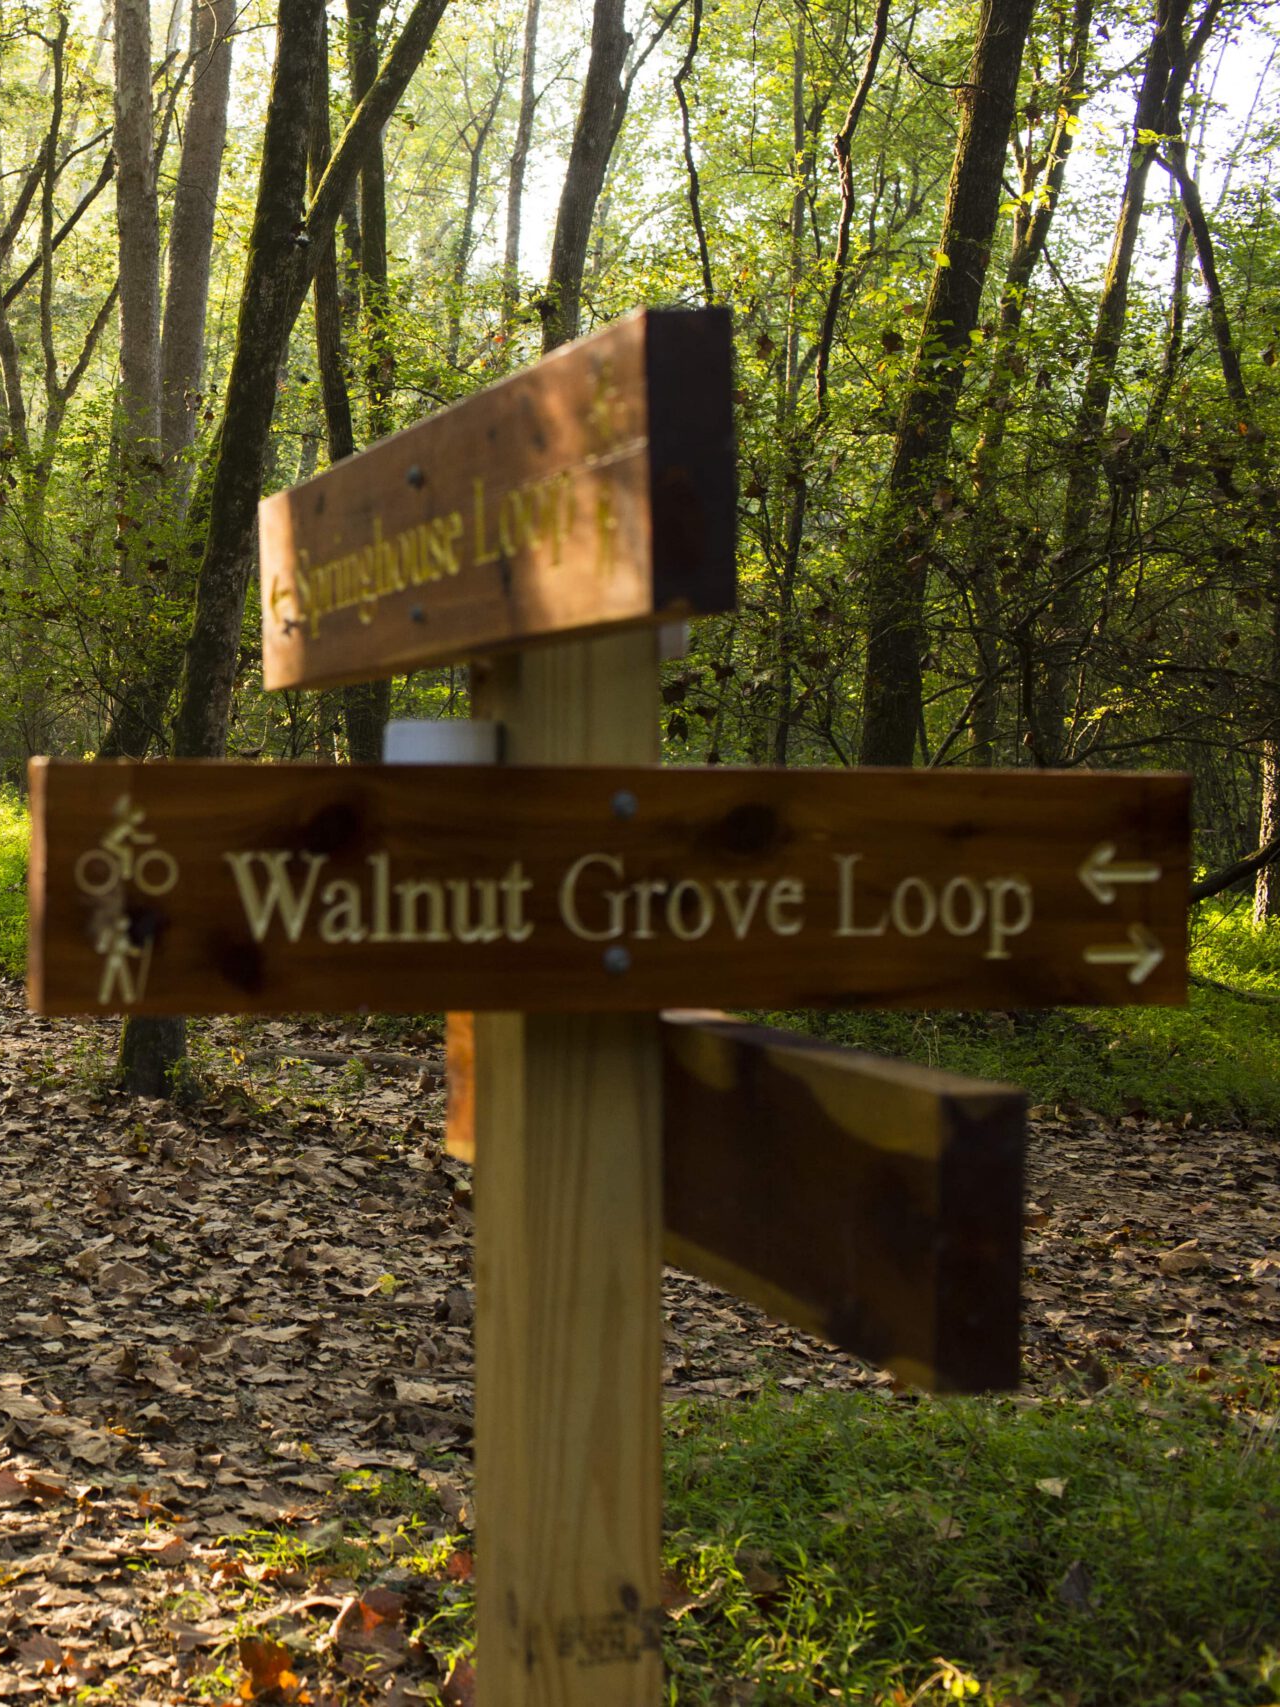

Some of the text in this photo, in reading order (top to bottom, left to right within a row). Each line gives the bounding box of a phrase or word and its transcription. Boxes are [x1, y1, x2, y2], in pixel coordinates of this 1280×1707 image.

[295, 472, 577, 640] Springhouse Loop
[223, 850, 1034, 960] Walnut Grove Loop
